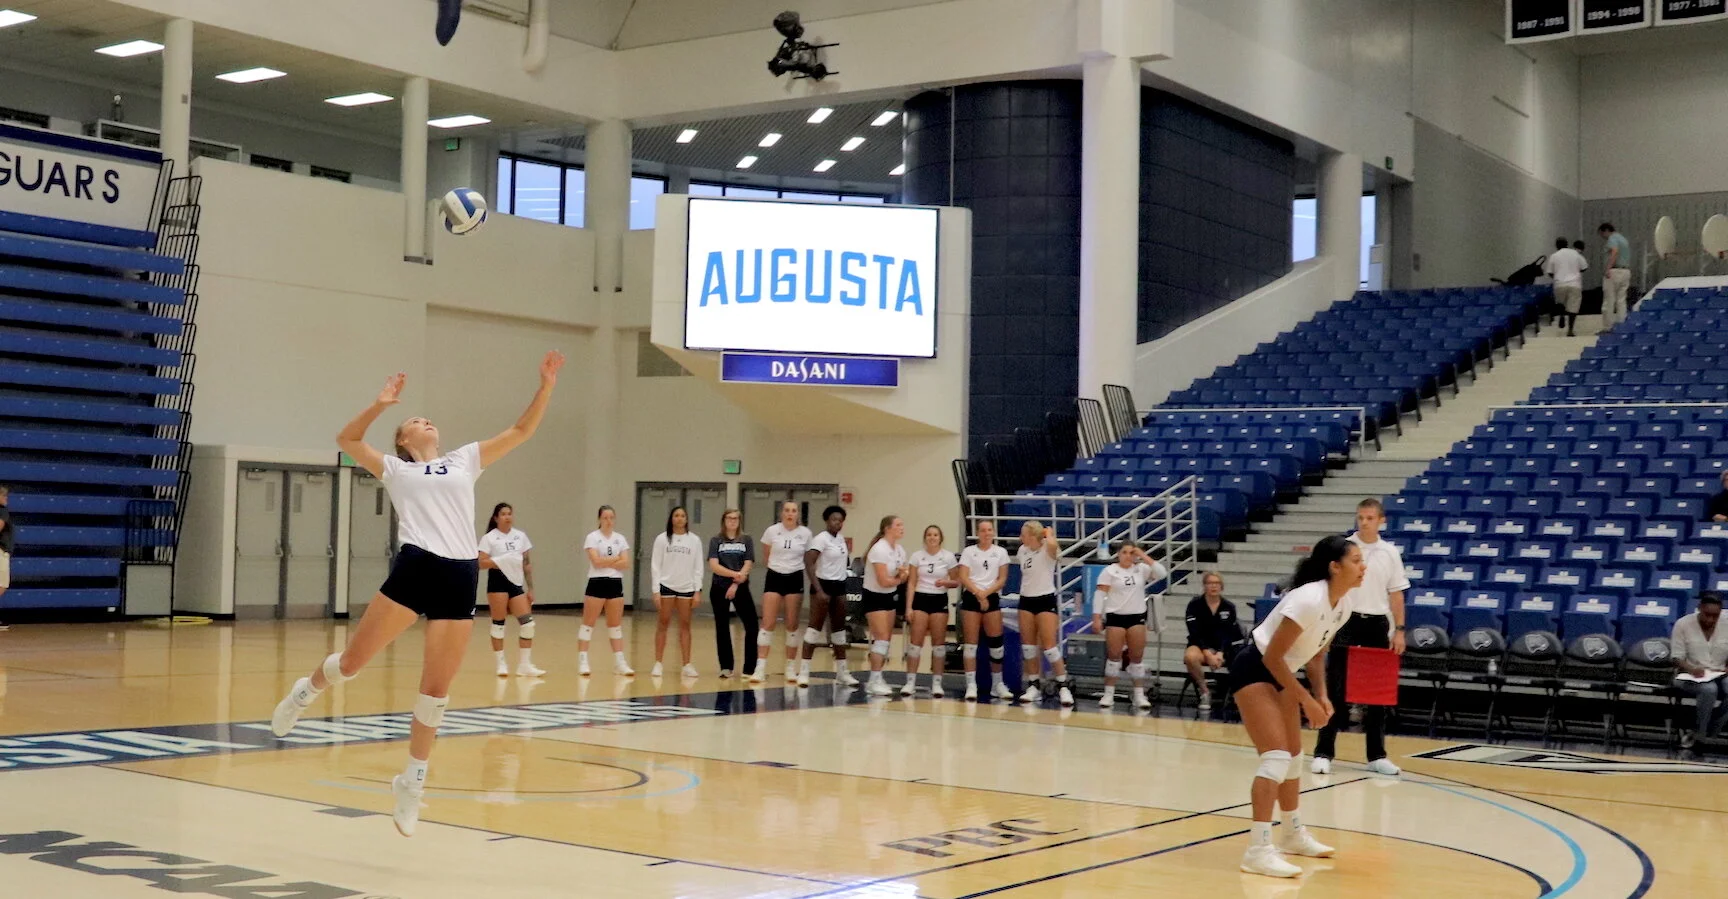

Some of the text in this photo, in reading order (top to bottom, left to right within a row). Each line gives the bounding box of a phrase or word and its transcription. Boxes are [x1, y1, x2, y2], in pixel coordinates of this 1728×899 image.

[1668, 1, 1690, 11] 1977
[700, 248, 923, 316] AUGUSTA
[771, 357, 845, 382] DASANI
[424, 465, 448, 475] 13
[505, 542, 515, 551] 15
[784, 540, 792, 549] 11
[927, 563, 935, 574] 3
[983, 560, 989, 571] 4
[1023, 557, 1033, 569] 12
[1124, 576, 1136, 586] 21
[0, 731, 266, 768] STA
[879, 818, 1078, 858] PBC
[0, 830, 366, 899] NCAA
